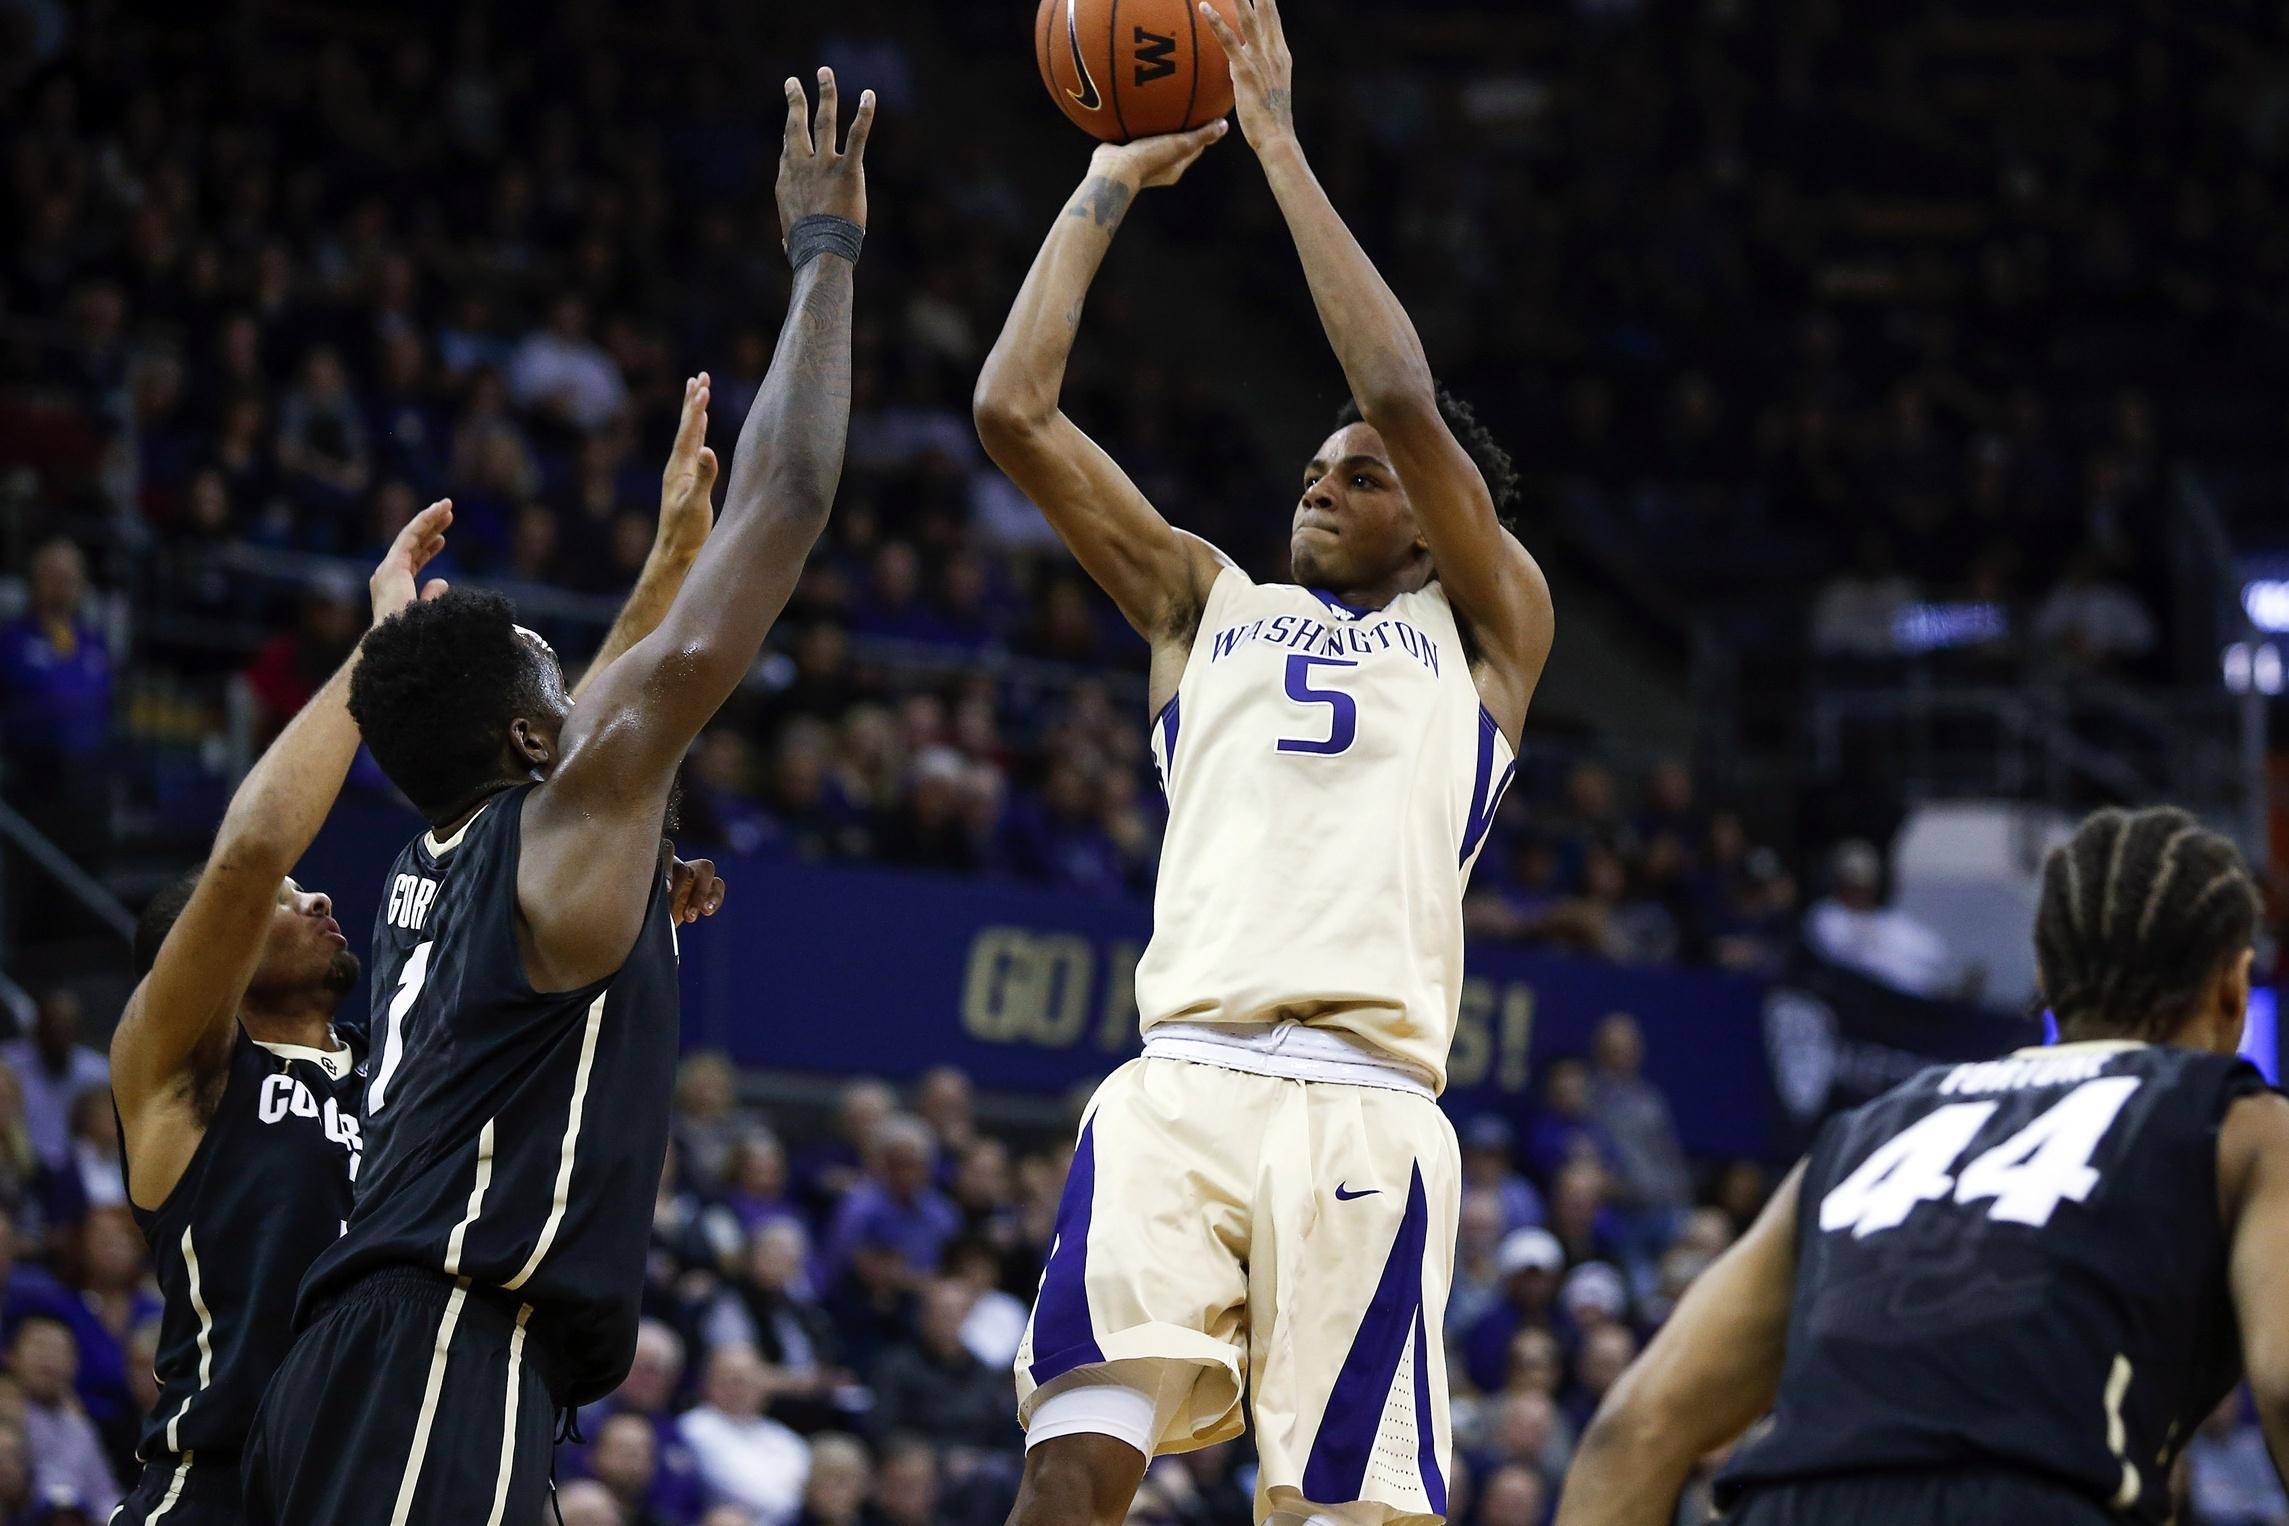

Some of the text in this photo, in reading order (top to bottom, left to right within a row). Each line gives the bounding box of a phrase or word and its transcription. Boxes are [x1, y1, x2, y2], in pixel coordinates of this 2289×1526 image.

[1134, 25, 1177, 87] W
[1275, 653, 1358, 757] 5
[367, 940, 435, 1118] 1
[964, 927, 1092, 1046] GO
[1819, 1076, 2142, 1240] 44
